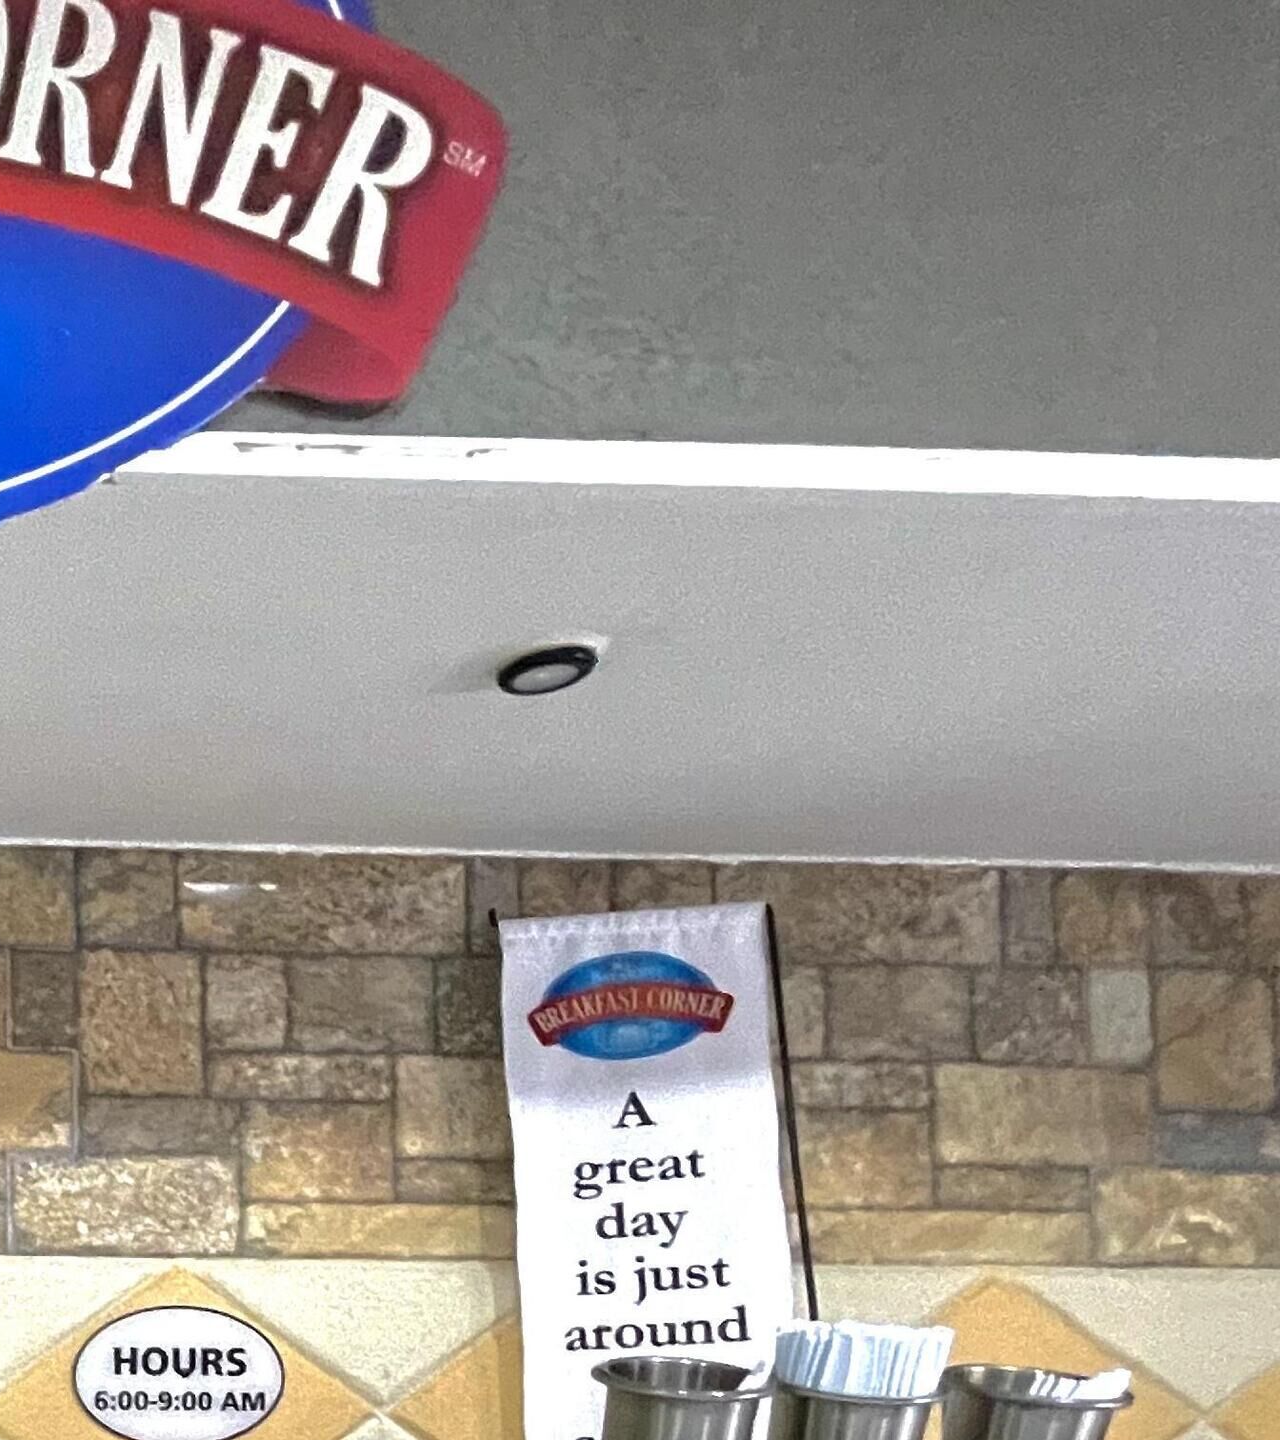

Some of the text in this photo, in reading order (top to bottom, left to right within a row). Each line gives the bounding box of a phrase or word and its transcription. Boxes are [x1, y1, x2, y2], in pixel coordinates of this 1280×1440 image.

[532, 987, 727, 1033] BREAKFAST CORNER
[611, 1090, 658, 1129] A
[572, 1149, 706, 1200] great
[594, 1202, 689, 1248] day
[575, 1255, 732, 1306] is just
[564, 1304, 752, 1352] around
[112, 1346, 248, 1378] HOURS
[94, 1390, 266, 1412] 6:00-9:00 AM
